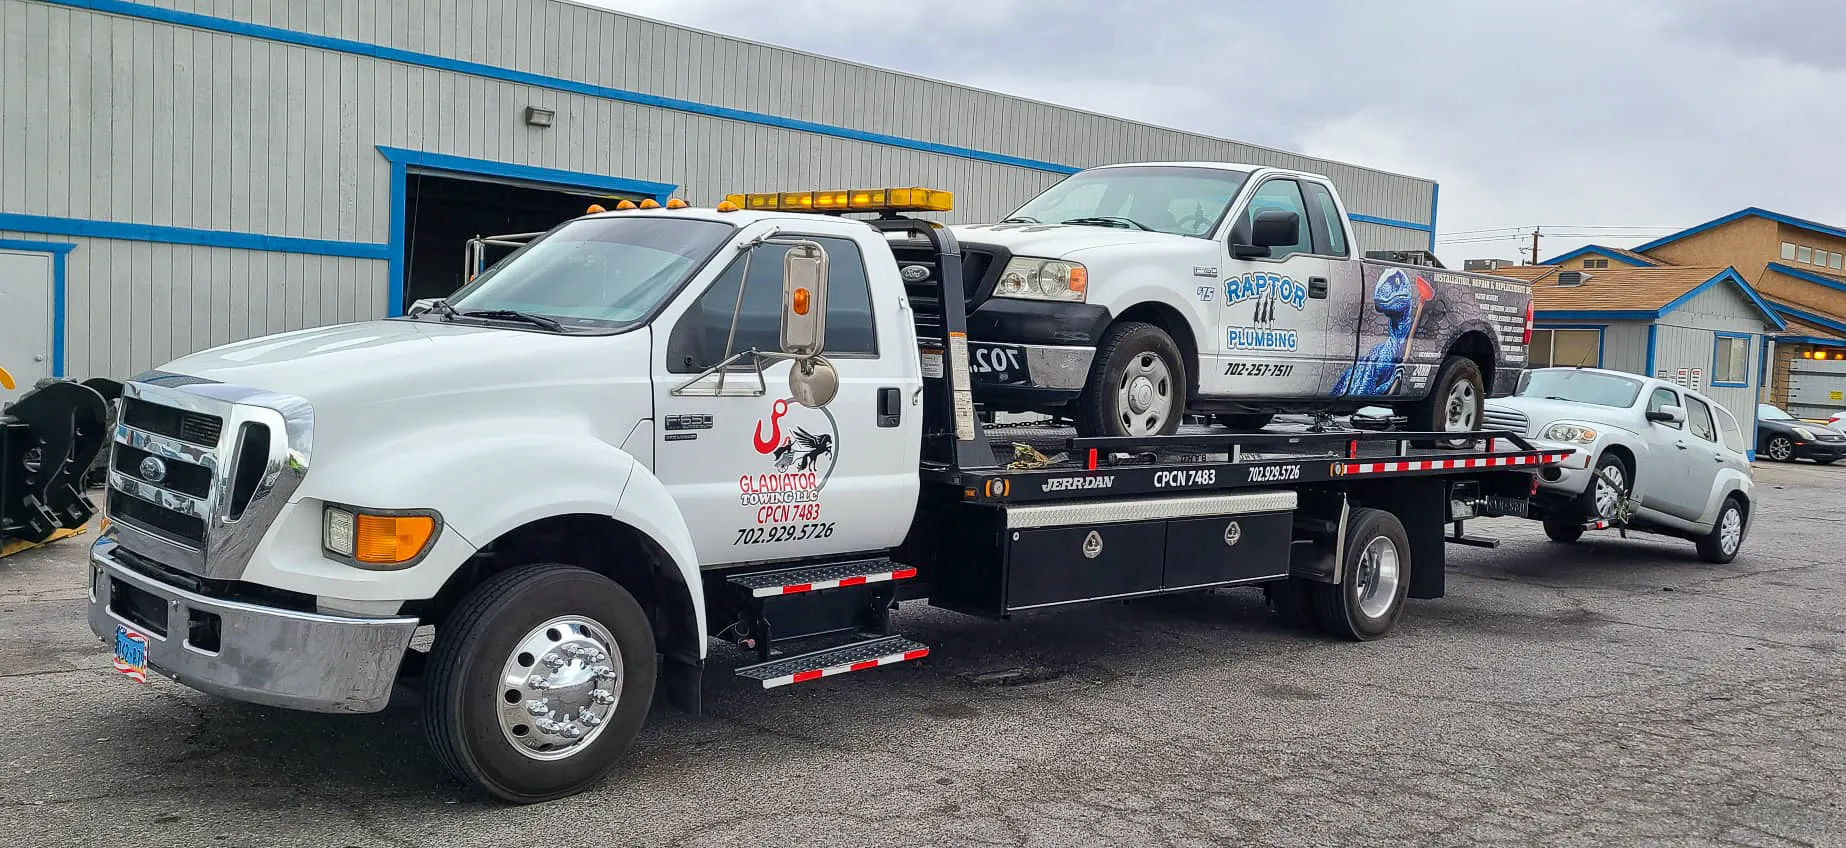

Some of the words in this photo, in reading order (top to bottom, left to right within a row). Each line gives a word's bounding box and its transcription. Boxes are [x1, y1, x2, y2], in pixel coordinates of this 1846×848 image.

[1225, 273, 1307, 311] RAPTOR
[1228, 328, 1297, 350] PLUMBING
[1224, 362, 1293, 377] 702-257-7511
[739, 472, 817, 493] GLADIATOR
[1154, 471, 1187, 487] CPCN
[1188, 469, 1216, 486] 7483
[1247, 464, 1301, 482] 702.929.5726
[741, 491, 794, 505] TOWING
[795, 490, 818, 502] LLC
[757, 505, 790, 524] CPCN
[791, 503, 820, 521] 7483
[733, 522, 836, 546] 702.929.5726
